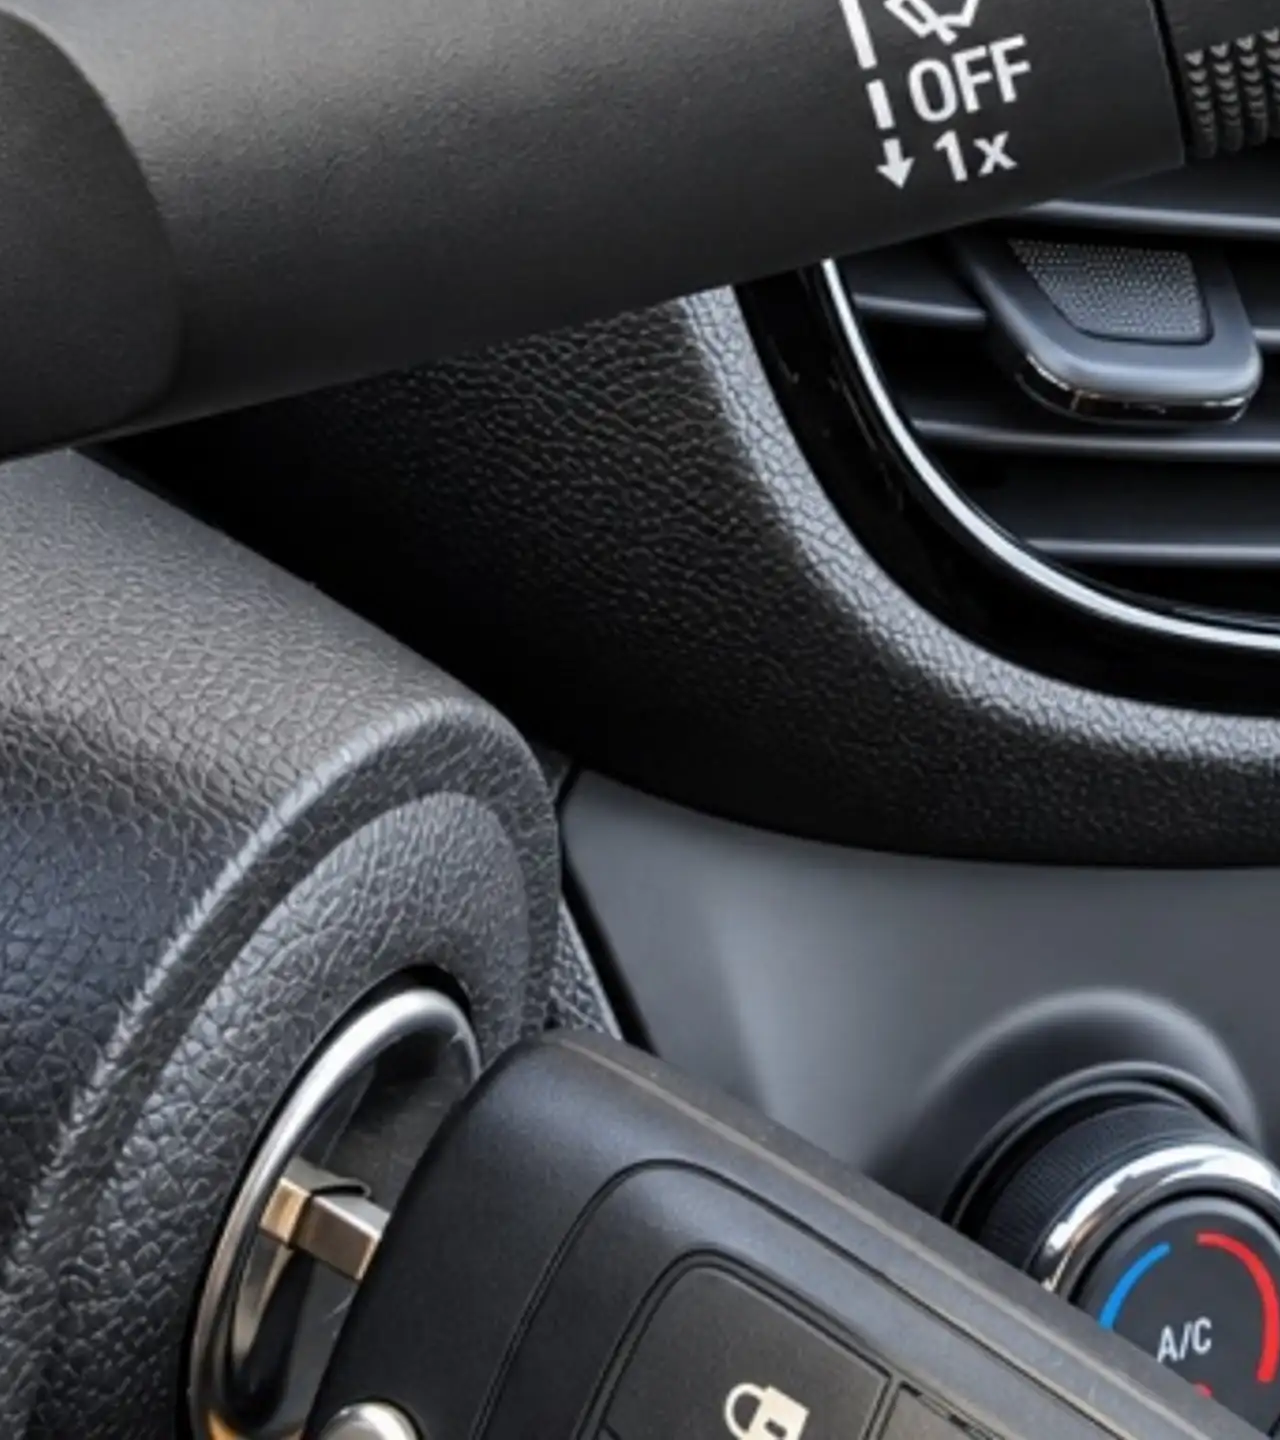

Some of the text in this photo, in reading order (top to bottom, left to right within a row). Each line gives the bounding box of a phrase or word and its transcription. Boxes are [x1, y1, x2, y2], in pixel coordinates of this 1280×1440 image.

[907, 34, 1032, 123] OFF
[933, 130, 1017, 183] 1x
[1157, 1317, 1213, 1364] A/C
